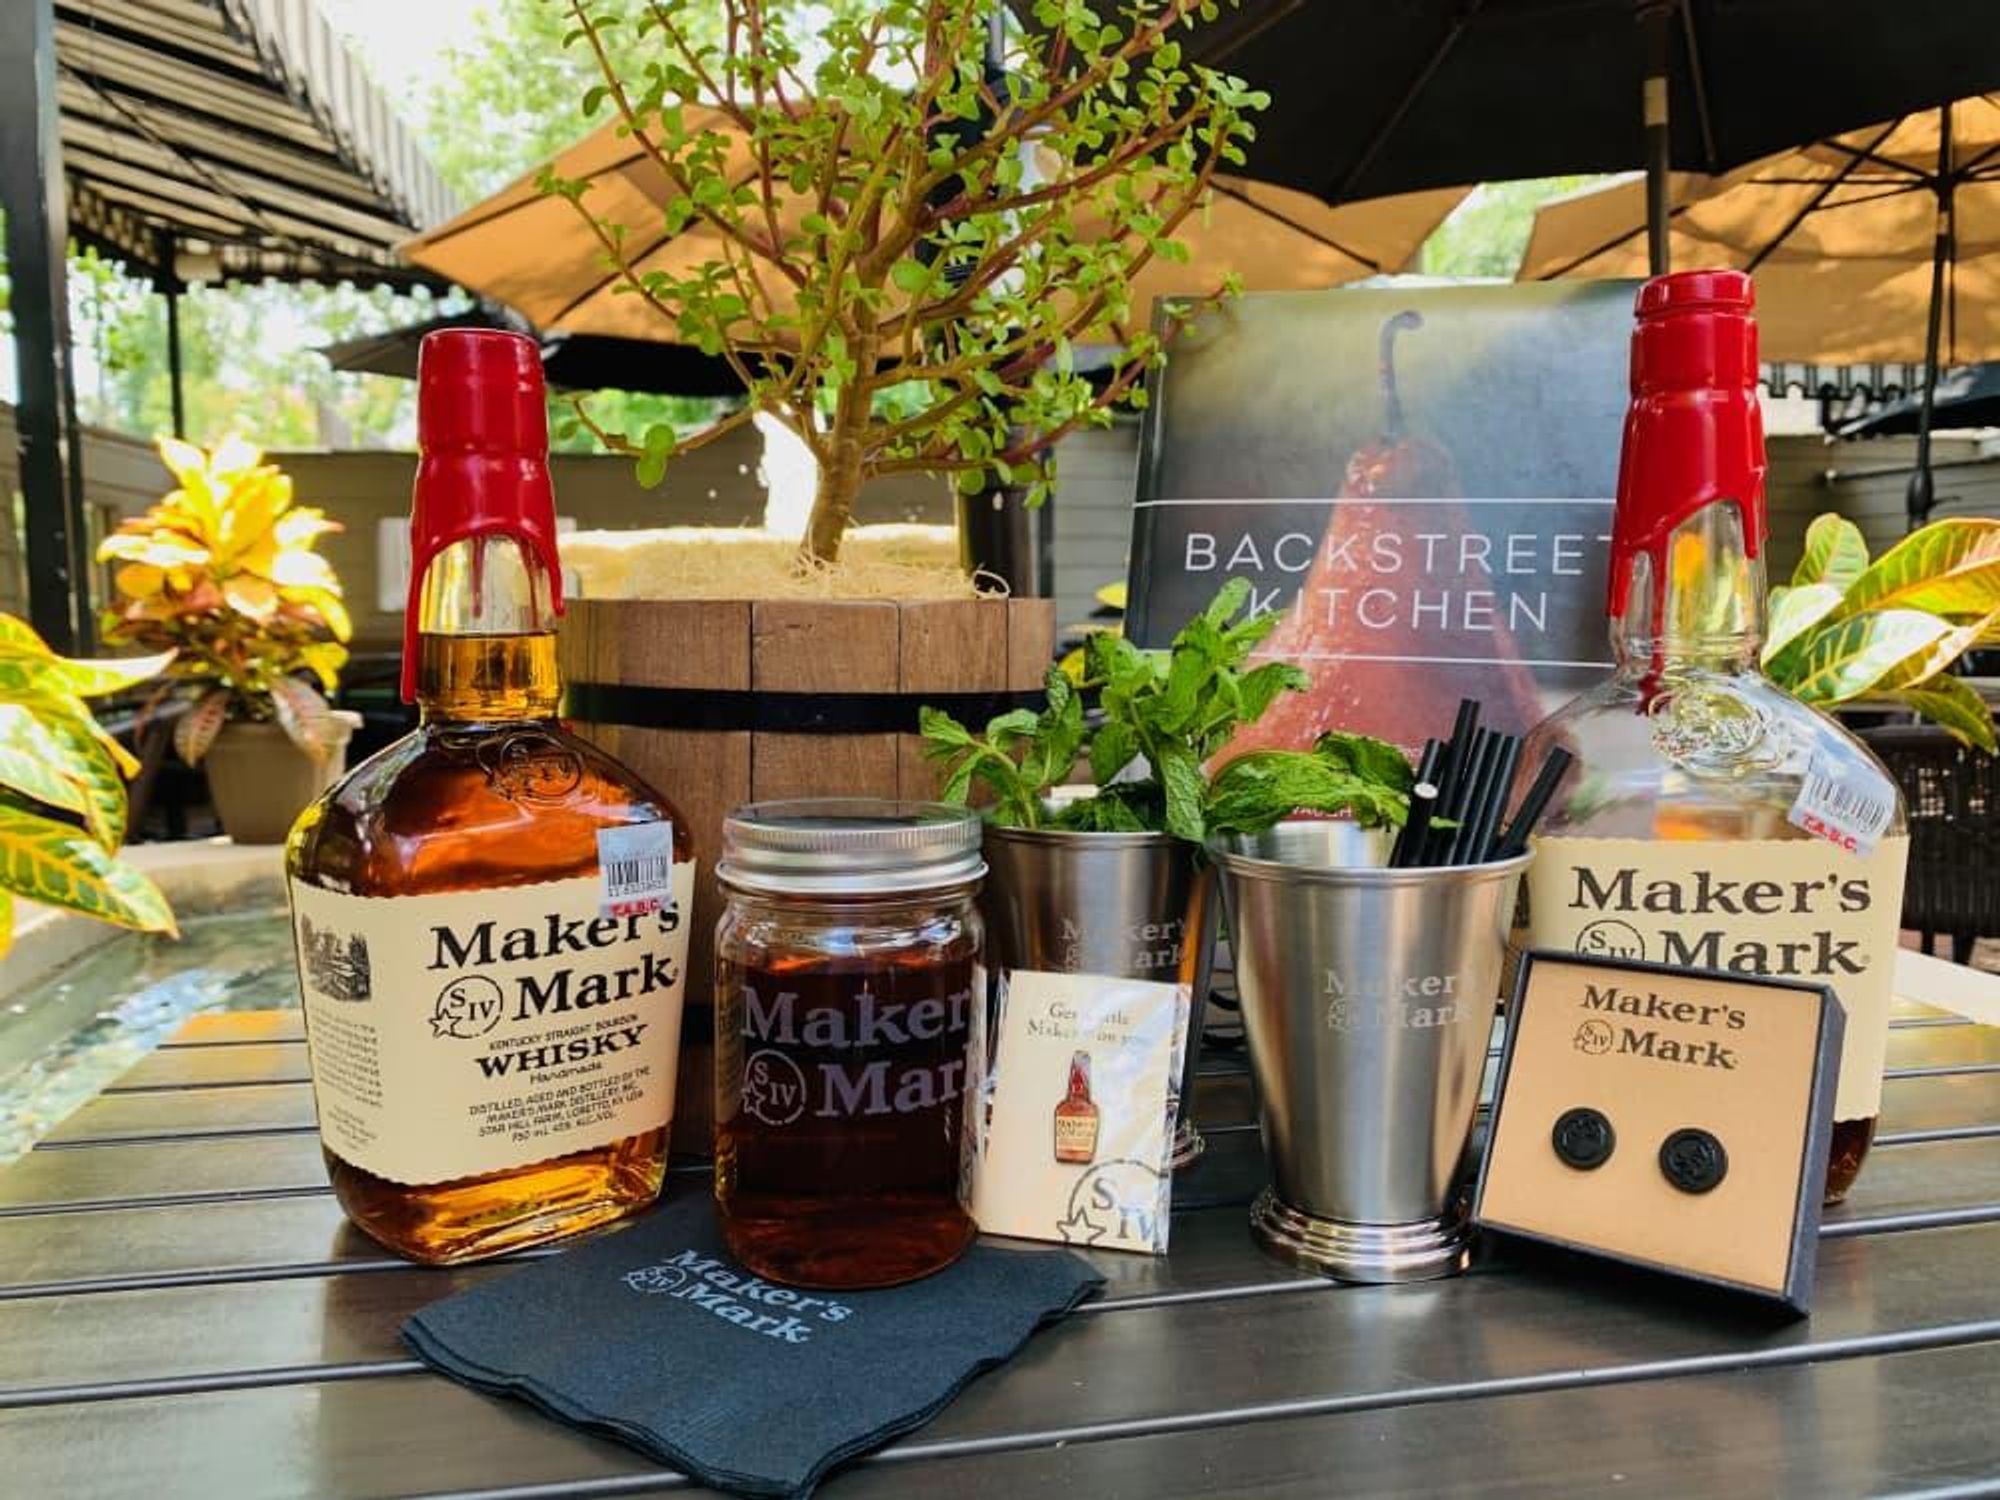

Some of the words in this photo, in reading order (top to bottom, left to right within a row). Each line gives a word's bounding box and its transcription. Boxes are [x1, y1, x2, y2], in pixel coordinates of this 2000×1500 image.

[1184, 532, 1612, 576] BACKSTREE
[1247, 587, 1548, 633] KITCHEN
[1567, 866, 1872, 914] Maker's
[1658, 931, 1867, 976] Mark
[511, 952, 676, 1021] Mark
[1579, 984, 1746, 1030] Maker's
[474, 1024, 648, 1078] WHISKY
[489, 1034, 541, 1051] KENTUCKY
[545, 1024, 591, 1042] STRAIGHT
[1615, 1027, 1737, 1070] Mark
[529, 1061, 603, 1084] Handmade
[661, 1248, 853, 1323] Maker's
[670, 1282, 813, 1344] Mark
